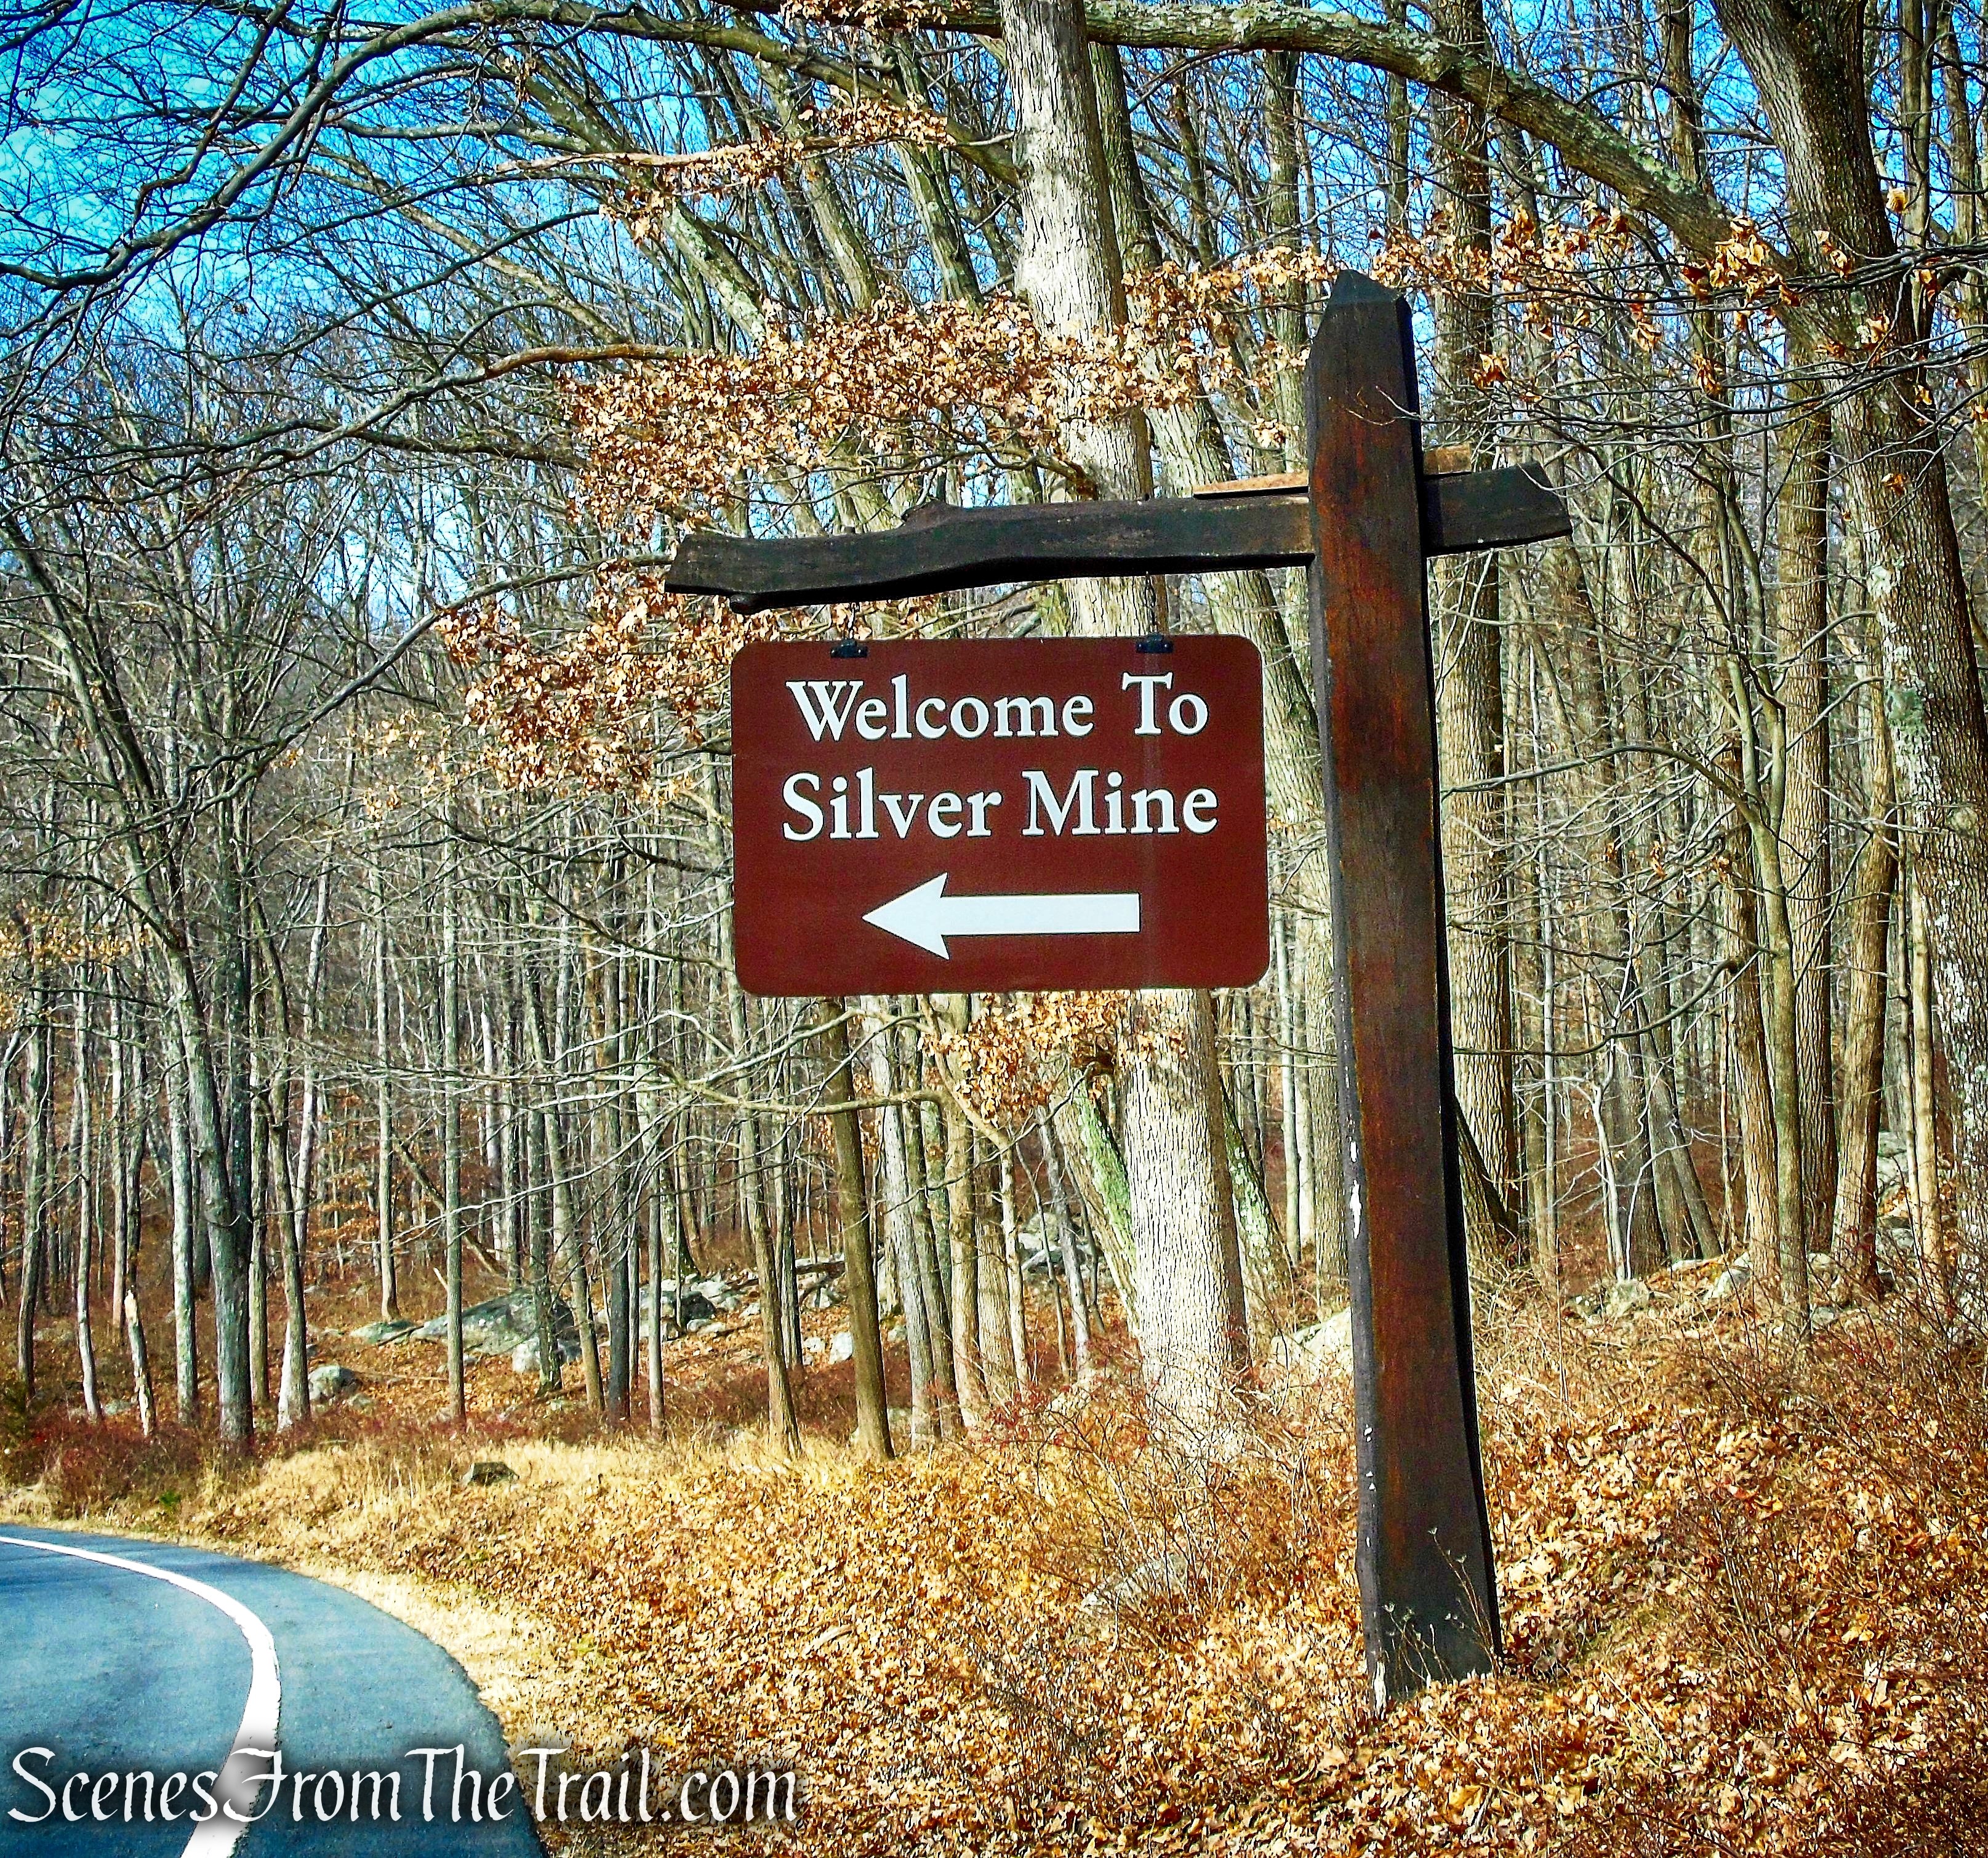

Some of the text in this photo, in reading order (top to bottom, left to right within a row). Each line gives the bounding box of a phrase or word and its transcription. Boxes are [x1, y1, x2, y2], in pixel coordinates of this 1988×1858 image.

[785, 672, 1209, 742] Welcome To
[782, 767, 1218, 841] Silver Mine
